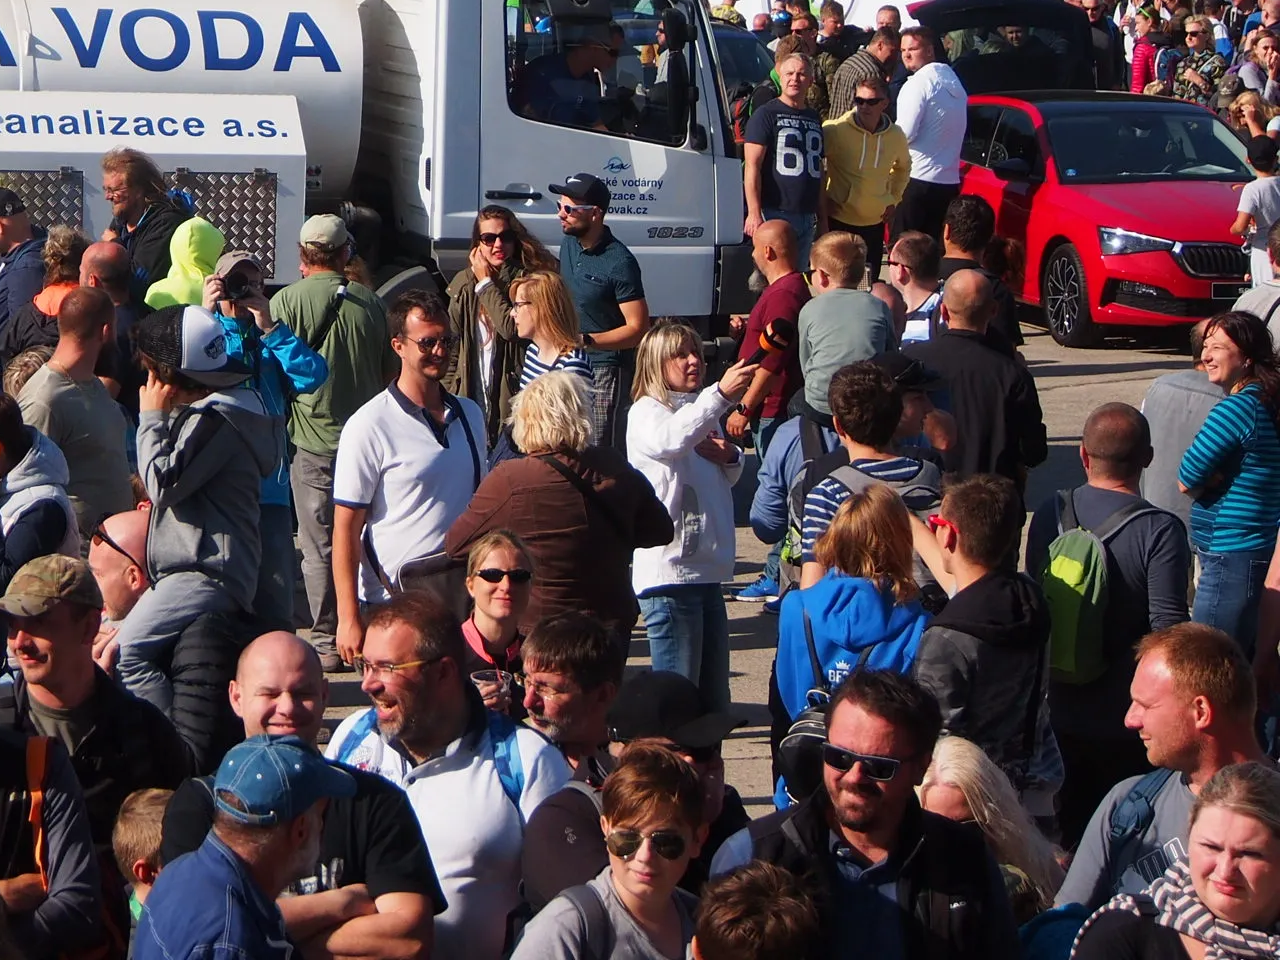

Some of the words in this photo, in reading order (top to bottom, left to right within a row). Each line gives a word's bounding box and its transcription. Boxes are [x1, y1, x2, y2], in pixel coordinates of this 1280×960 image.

[51, 6, 344, 73] VODA
[222, 118, 289, 138] a.s.
[776, 127, 823, 178] 68
[621, 177, 663, 189] vodárny
[609, 191, 636, 201] izace
[639, 193, 657, 201] a.s.
[607, 205, 648, 215] ovak.cz
